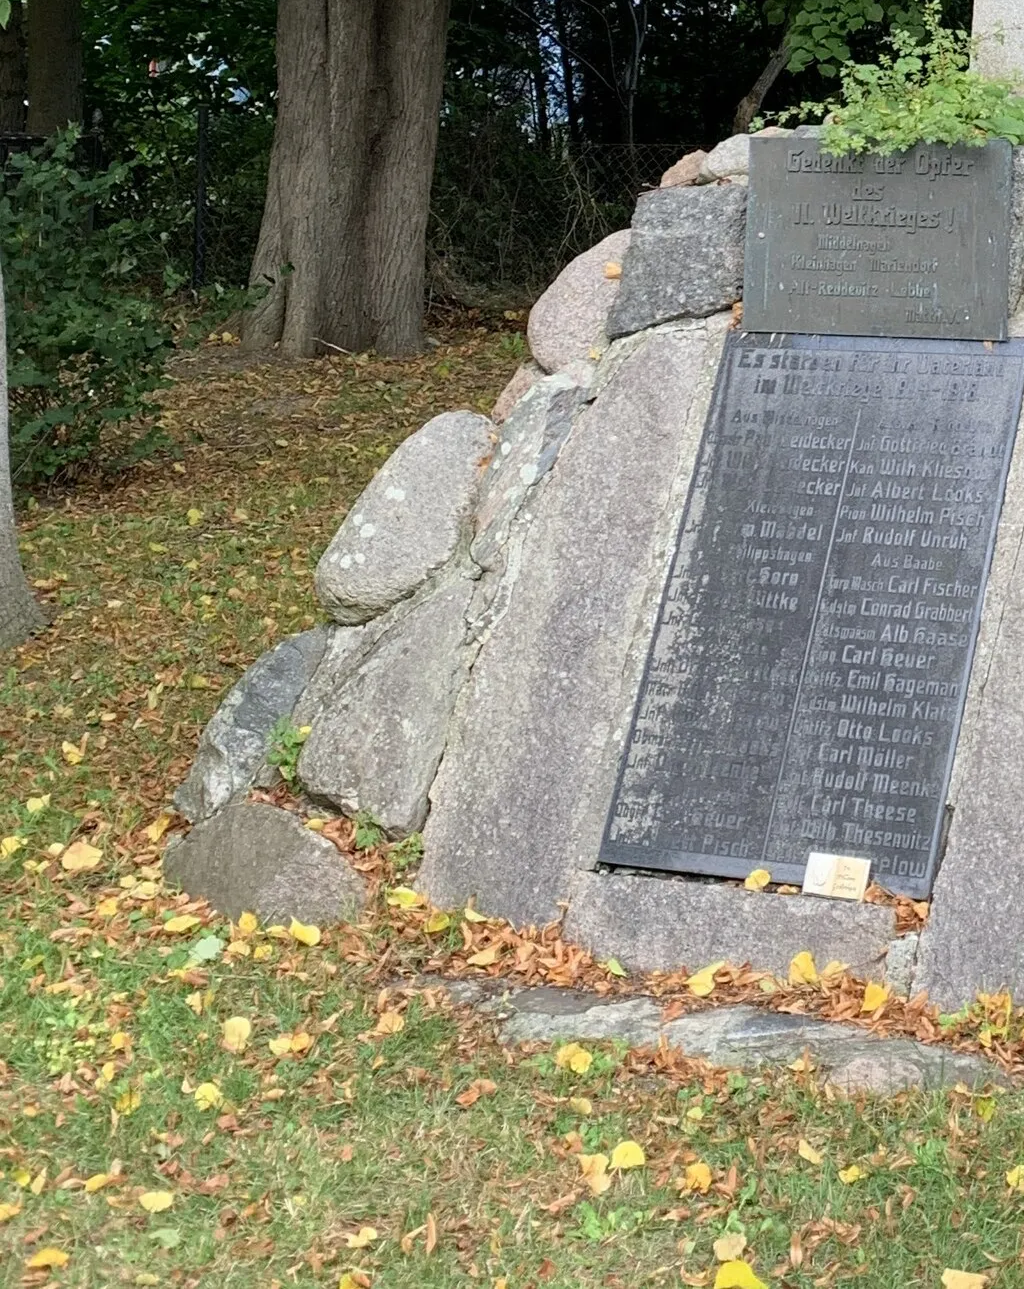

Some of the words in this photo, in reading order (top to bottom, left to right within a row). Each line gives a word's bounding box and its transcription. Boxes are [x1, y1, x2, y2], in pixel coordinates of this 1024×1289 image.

[875, 153, 907, 175] der
[915, 150, 974, 182] Opfer
[852, 180, 885, 202] des
[871, 481, 925, 500] Albert
[871, 504, 935, 525] Wilhelm
[862, 527, 917, 547] Rudolf
[871, 553, 900, 569] Aus
[888, 575, 920, 594] Carl
[922, 578, 979, 599] Fischer
[841, 645, 877, 665] Carl
[847, 670, 881, 691] Emil
[840, 694, 907, 718] Wilhelm
[878, 722, 934, 745] Looks
[818, 742, 854, 764] Carl
